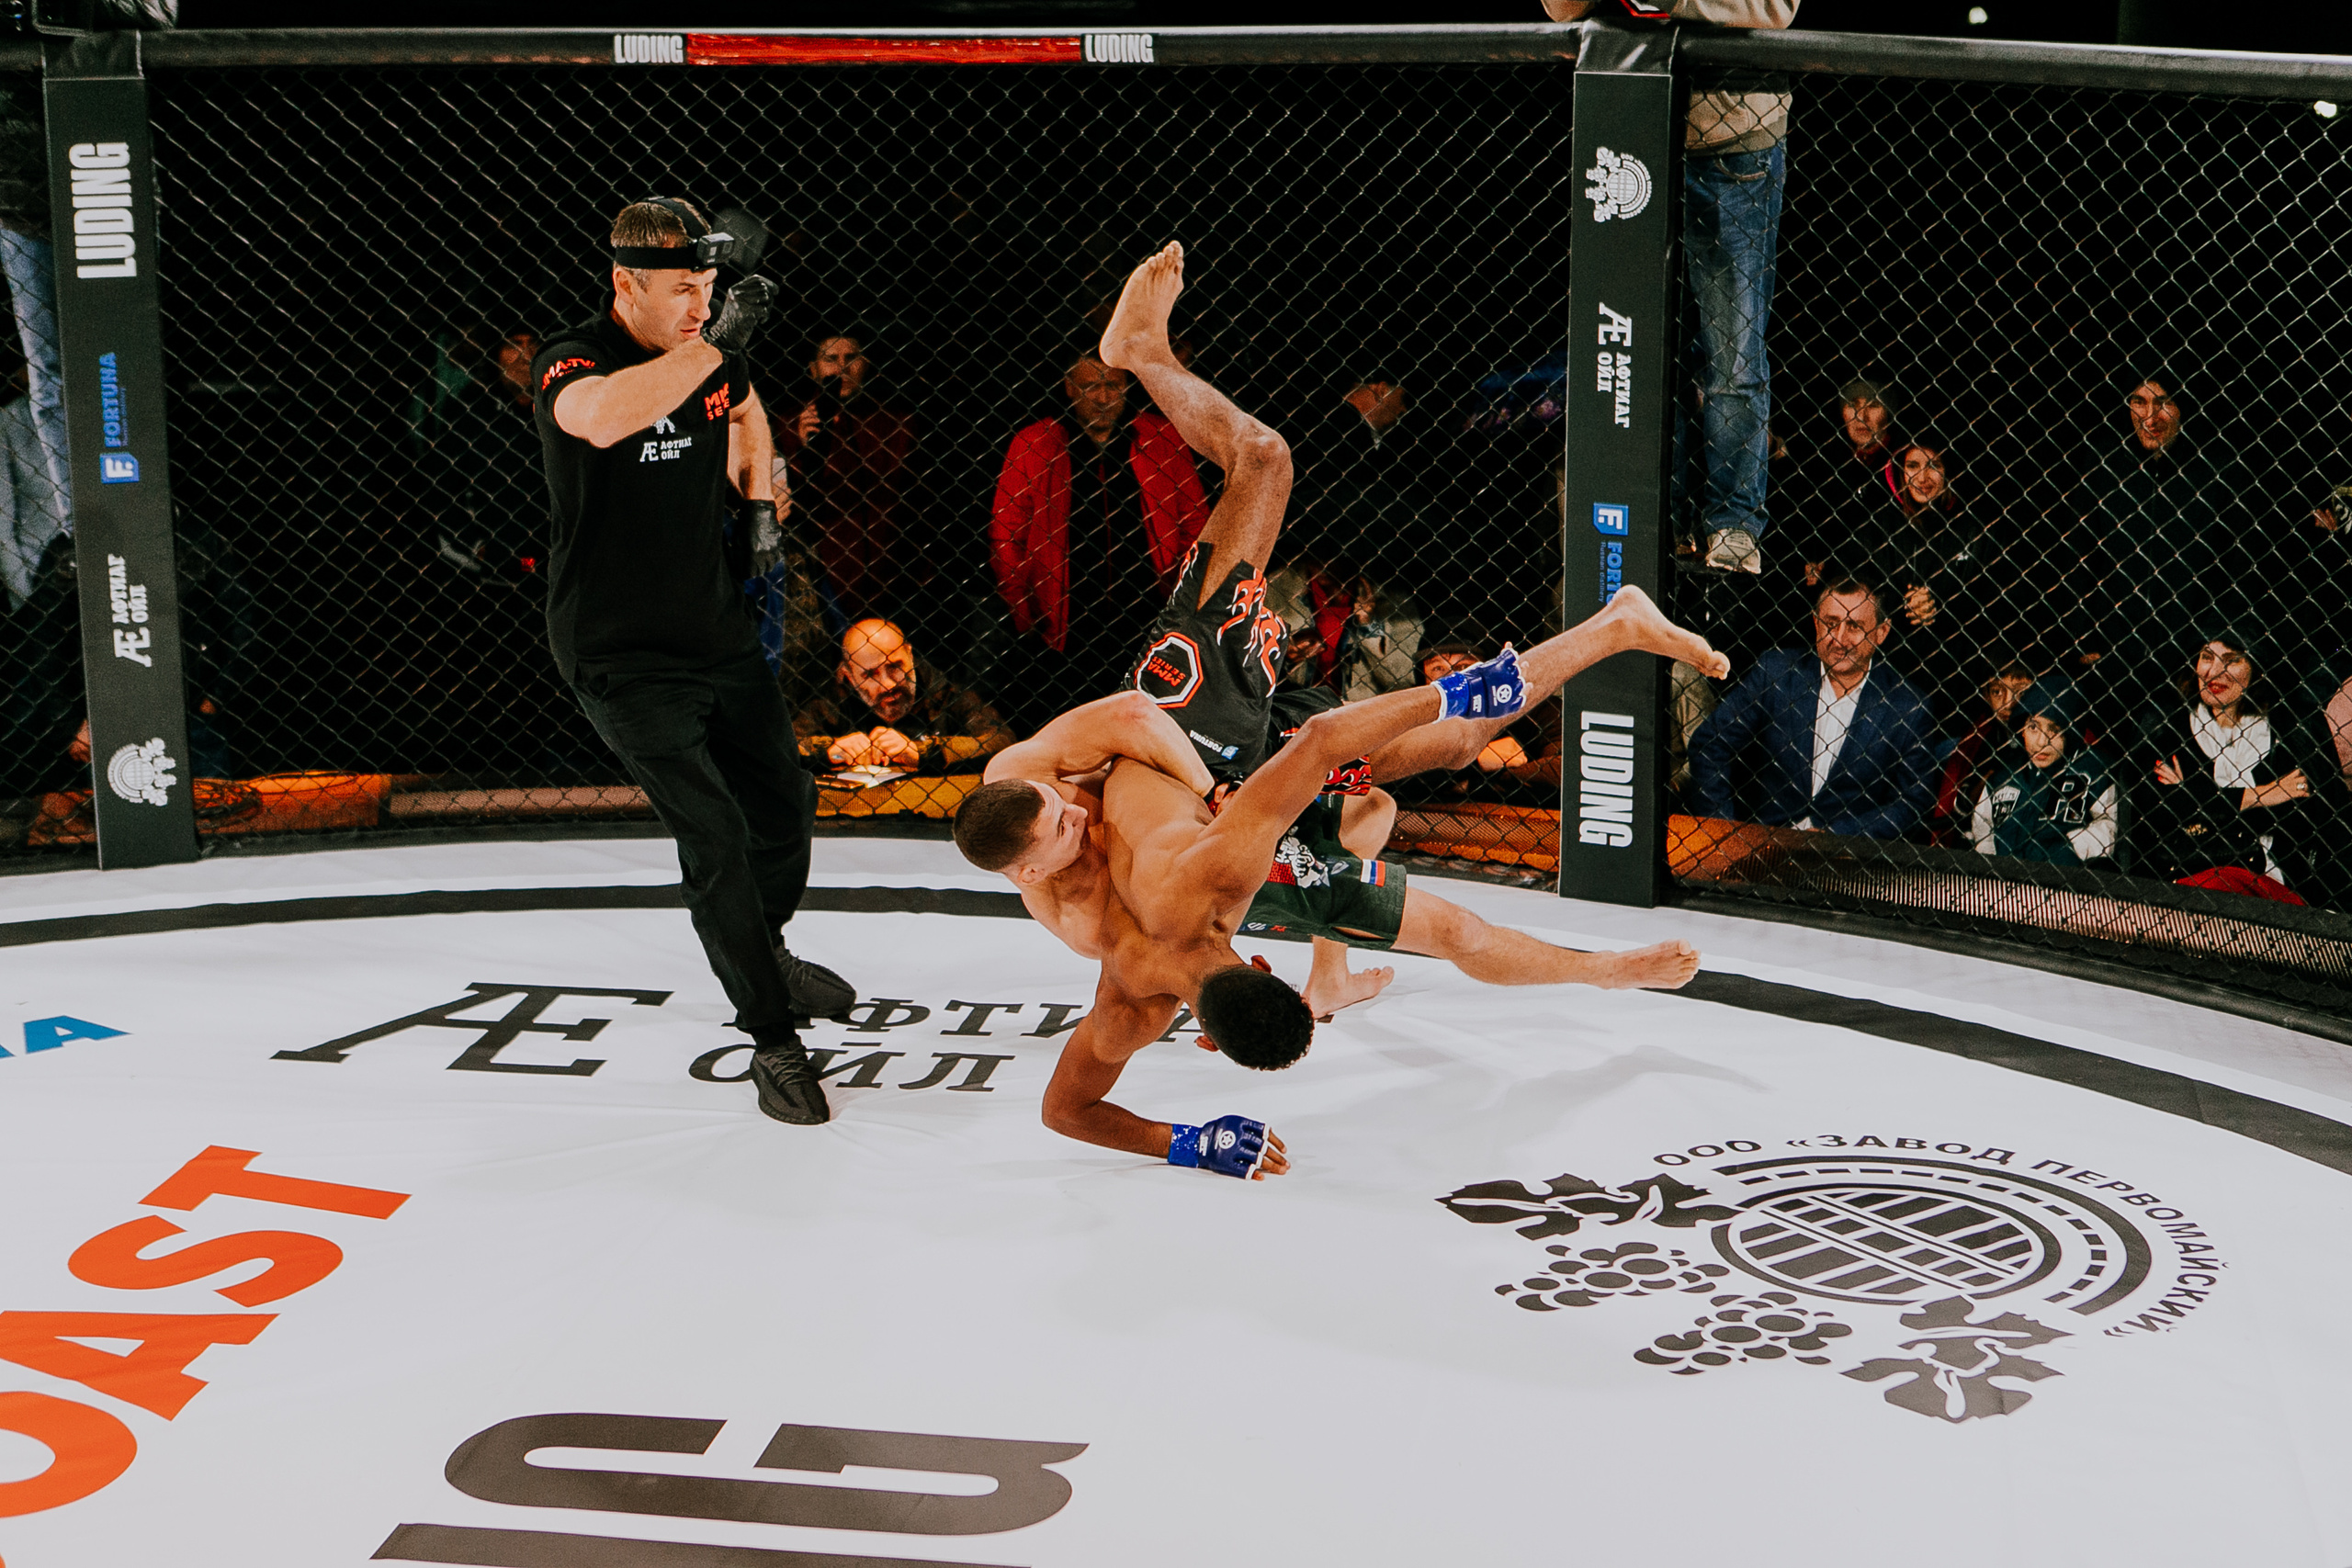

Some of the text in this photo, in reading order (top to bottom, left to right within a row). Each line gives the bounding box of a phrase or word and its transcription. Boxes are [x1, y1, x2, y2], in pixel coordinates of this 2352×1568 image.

[613, 34, 684, 64] LUDING
[1084, 33, 1154, 63] LUDING
[69, 141, 137, 278] LUDING
[1597, 352, 1613, 392] ОЙЛ
[99, 353, 121, 447] FORTUNA
[661, 449, 680, 460] ОЙЛ
[129, 583, 149, 624] ОЙЛ
[1148, 661, 1182, 687] MMA
[1151, 656, 1186, 681] SERIES
[1578, 710, 1634, 848] LUDING
[1653, 1134, 2231, 1338] ООО «ЗАВОД ПЕРВОМАЙСКИЙ»
